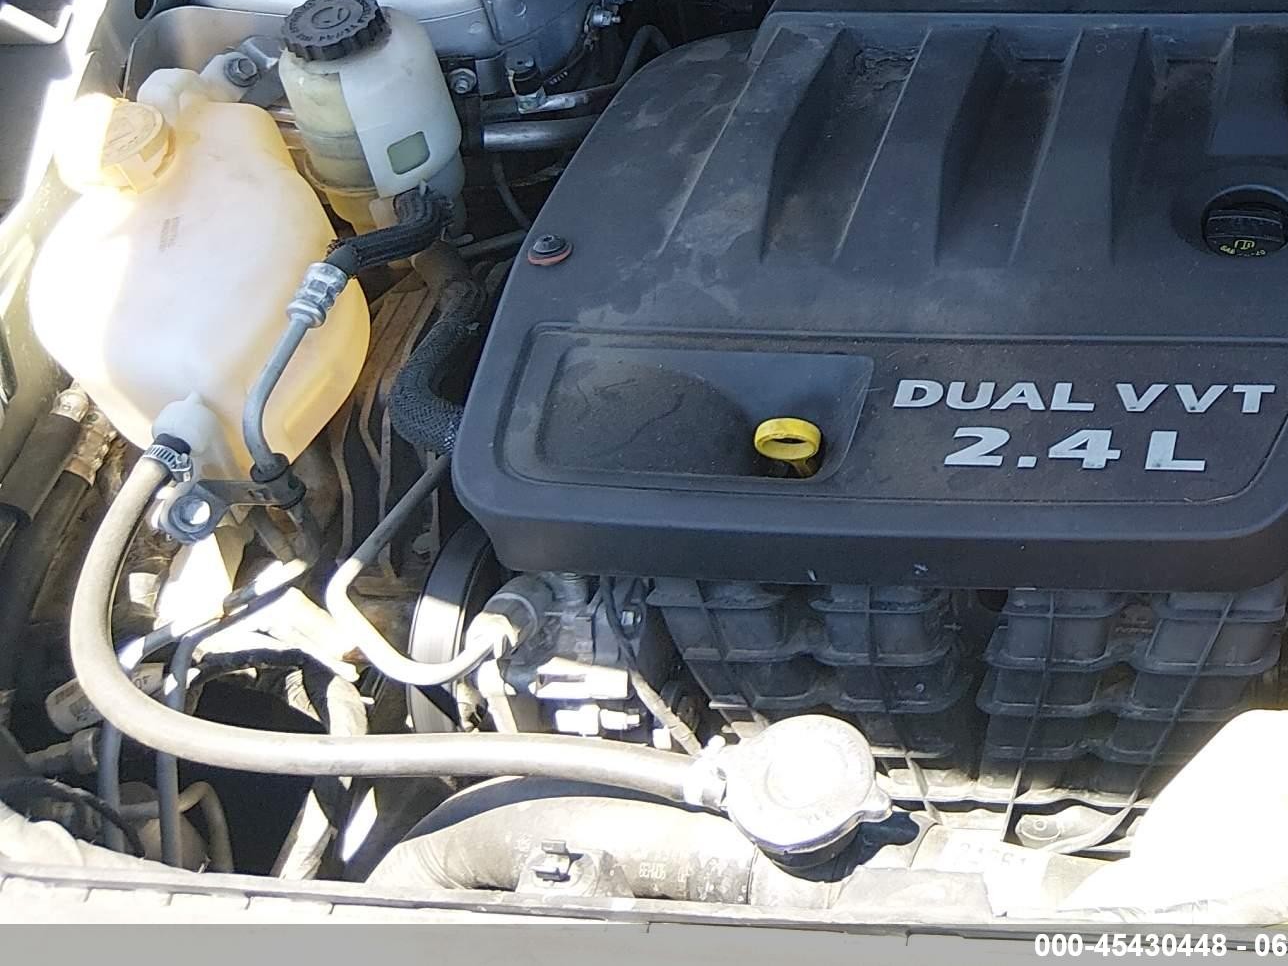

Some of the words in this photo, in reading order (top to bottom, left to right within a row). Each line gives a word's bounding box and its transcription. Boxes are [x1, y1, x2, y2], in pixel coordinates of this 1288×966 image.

[893, 379, 1095, 412] DUAL
[1116, 383, 1276, 414] VVT
[944, 427, 1121, 470] 2.4
[1144, 430, 1206, 472] L
